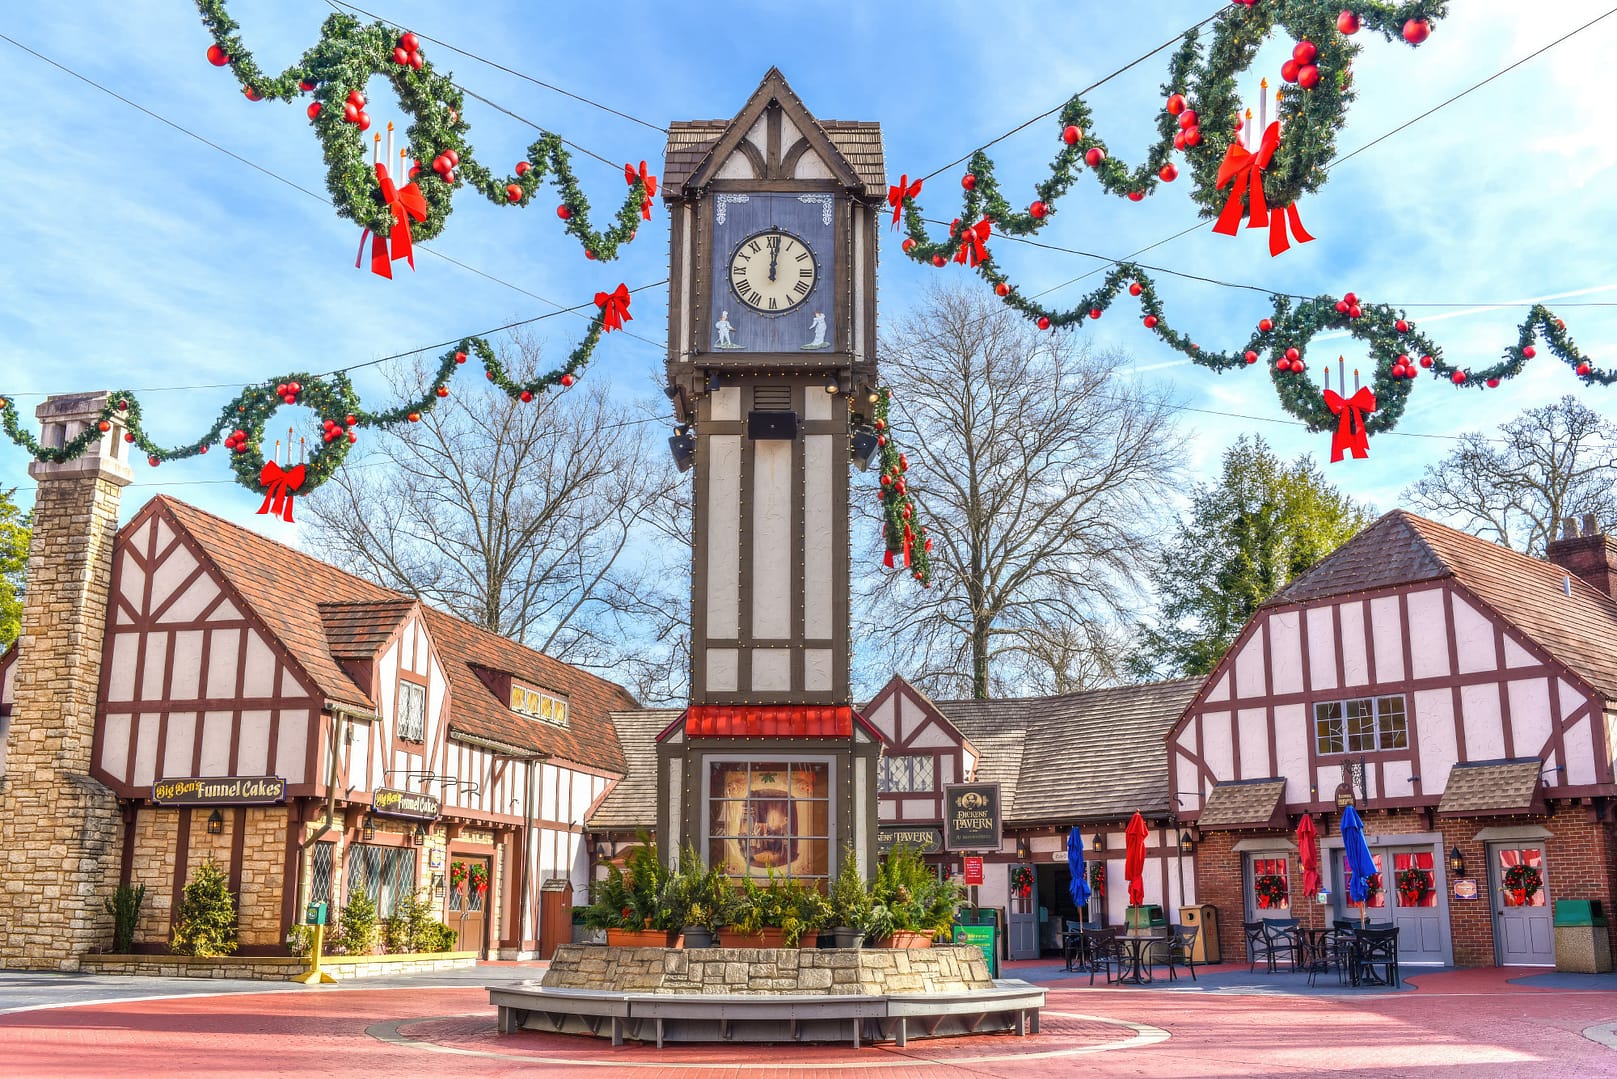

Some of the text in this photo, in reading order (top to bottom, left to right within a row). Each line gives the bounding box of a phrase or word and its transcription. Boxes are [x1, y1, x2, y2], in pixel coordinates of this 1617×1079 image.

[748, 240, 762, 254] XI
[786, 240, 794, 252] I
[738, 251, 751, 262] X
[795, 252, 809, 262] II
[734, 266, 746, 275] IX
[800, 268, 812, 278] III
[736, 279, 752, 296] VIII
[747, 291, 762, 307] VII
[768, 298, 778, 309] VI
[785, 294, 795, 306] V
[156, 780, 281, 799] Big Ben's Funnel Cakes
[420, 797, 438, 814] Cakes
[953, 818, 992, 830] TAVERN
[893, 831, 934, 843] TAVERN
